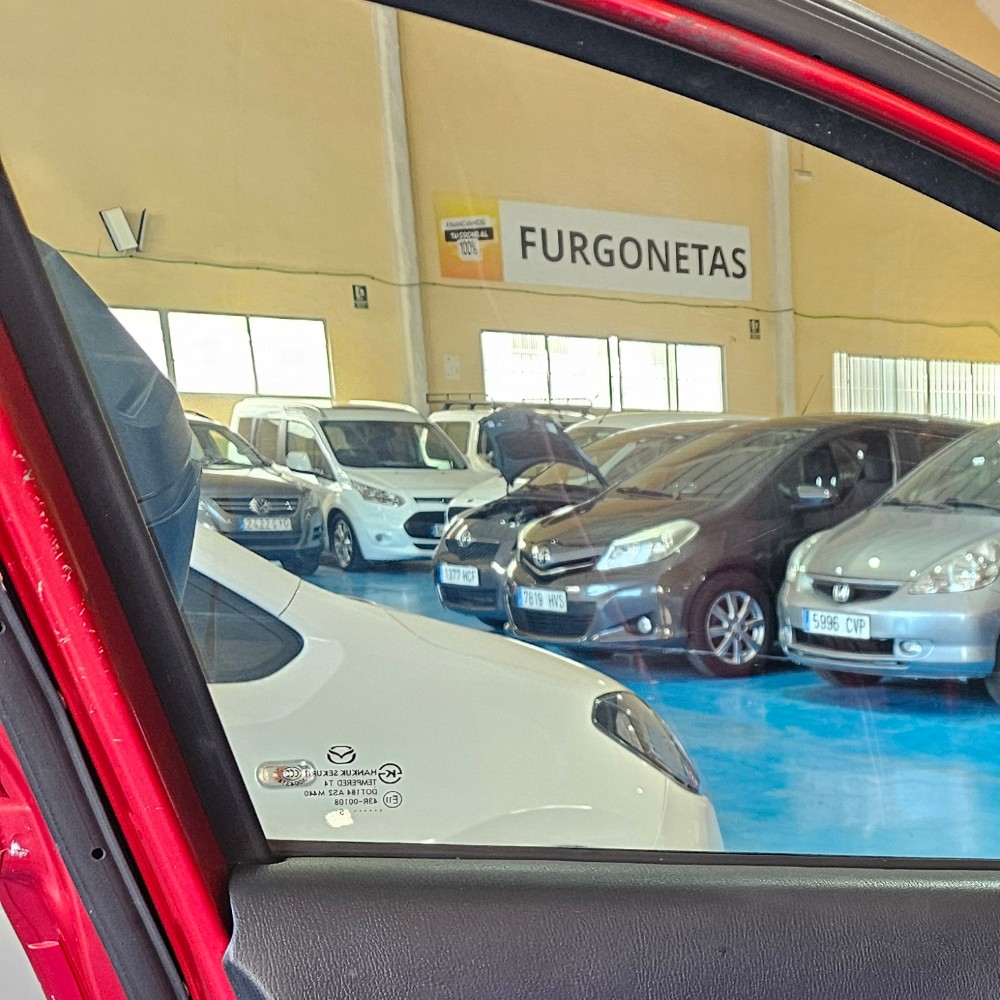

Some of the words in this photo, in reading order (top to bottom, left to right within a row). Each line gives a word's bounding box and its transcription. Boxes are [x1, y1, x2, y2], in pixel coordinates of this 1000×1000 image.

[520, 225, 747, 279] FURGONETAS
[812, 613, 840, 632] 5996
[846, 617, 866, 635] CVP
